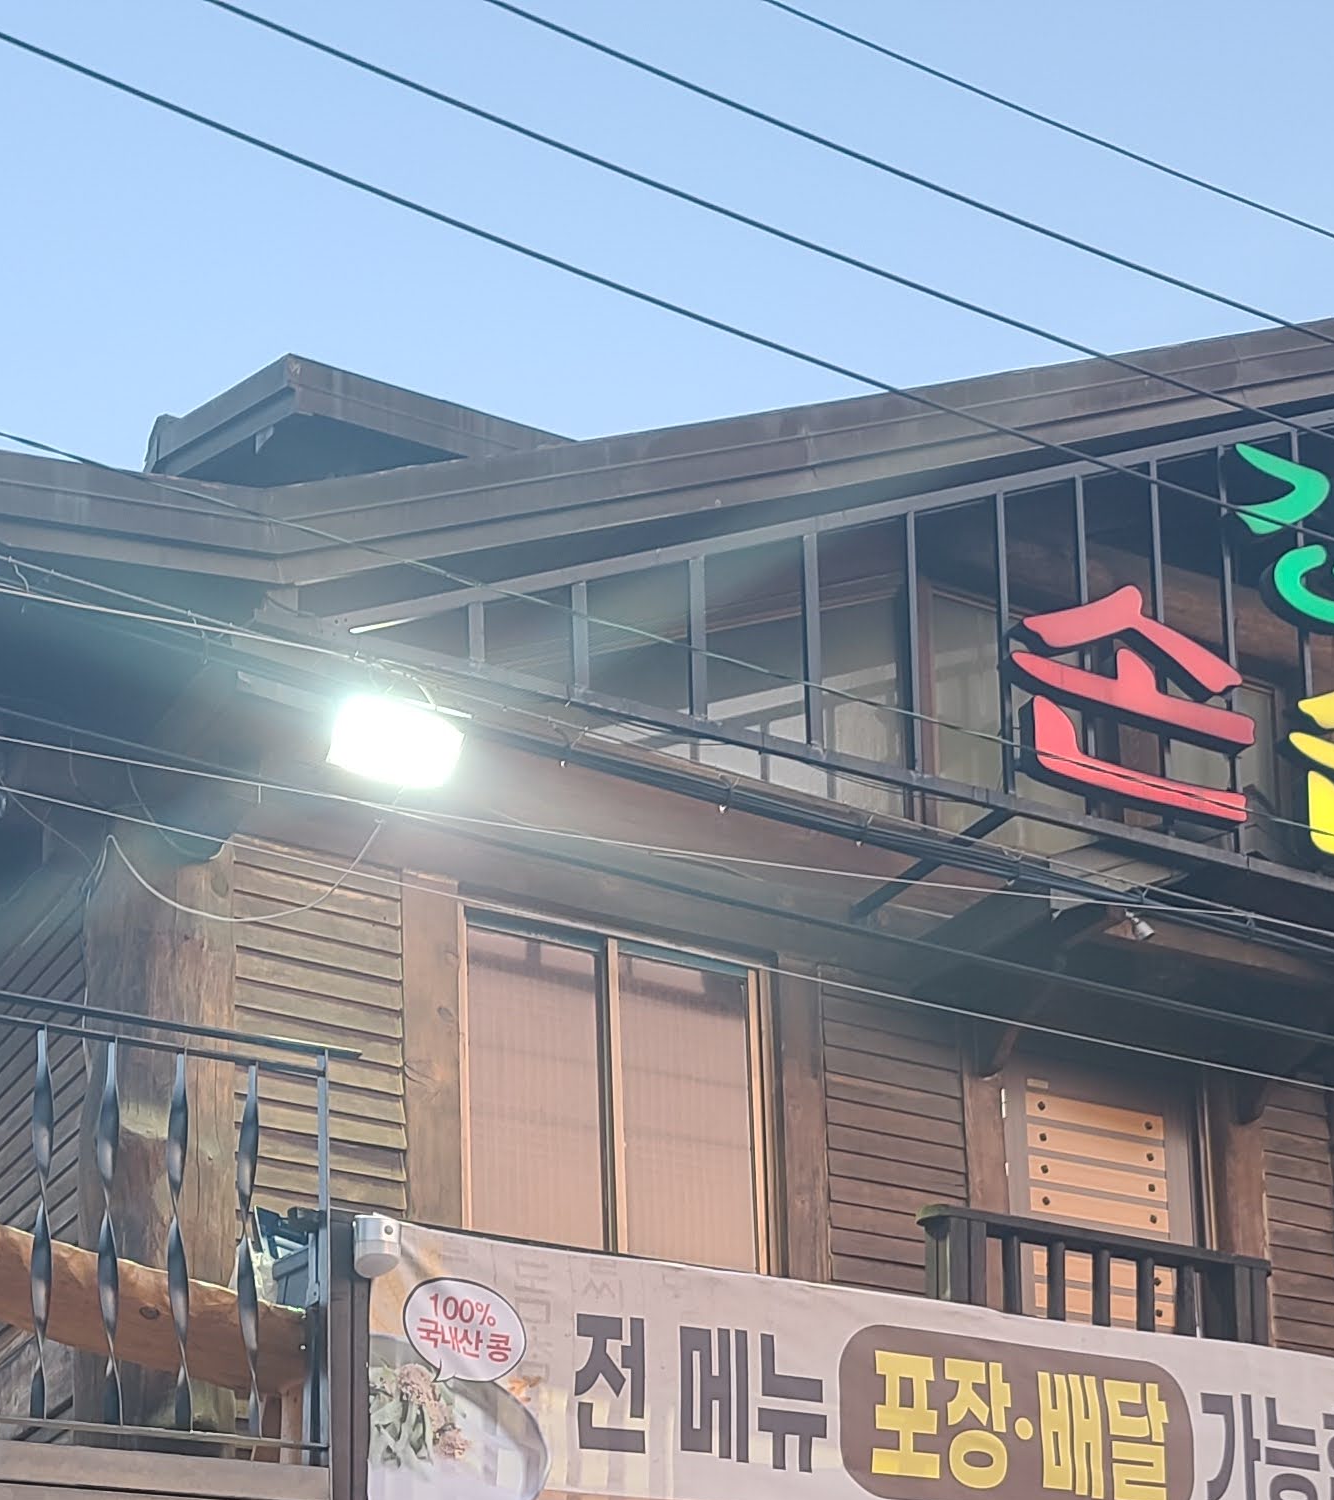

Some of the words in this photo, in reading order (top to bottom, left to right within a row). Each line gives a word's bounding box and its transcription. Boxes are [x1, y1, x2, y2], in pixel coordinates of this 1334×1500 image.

[428, 1292, 496, 1328] 100%
[417, 1317, 484, 1359] 국내산
[486, 1333, 513, 1363] 콩
[573, 1312, 647, 1455] 전
[678, 1325, 829, 1474] 메뉴
